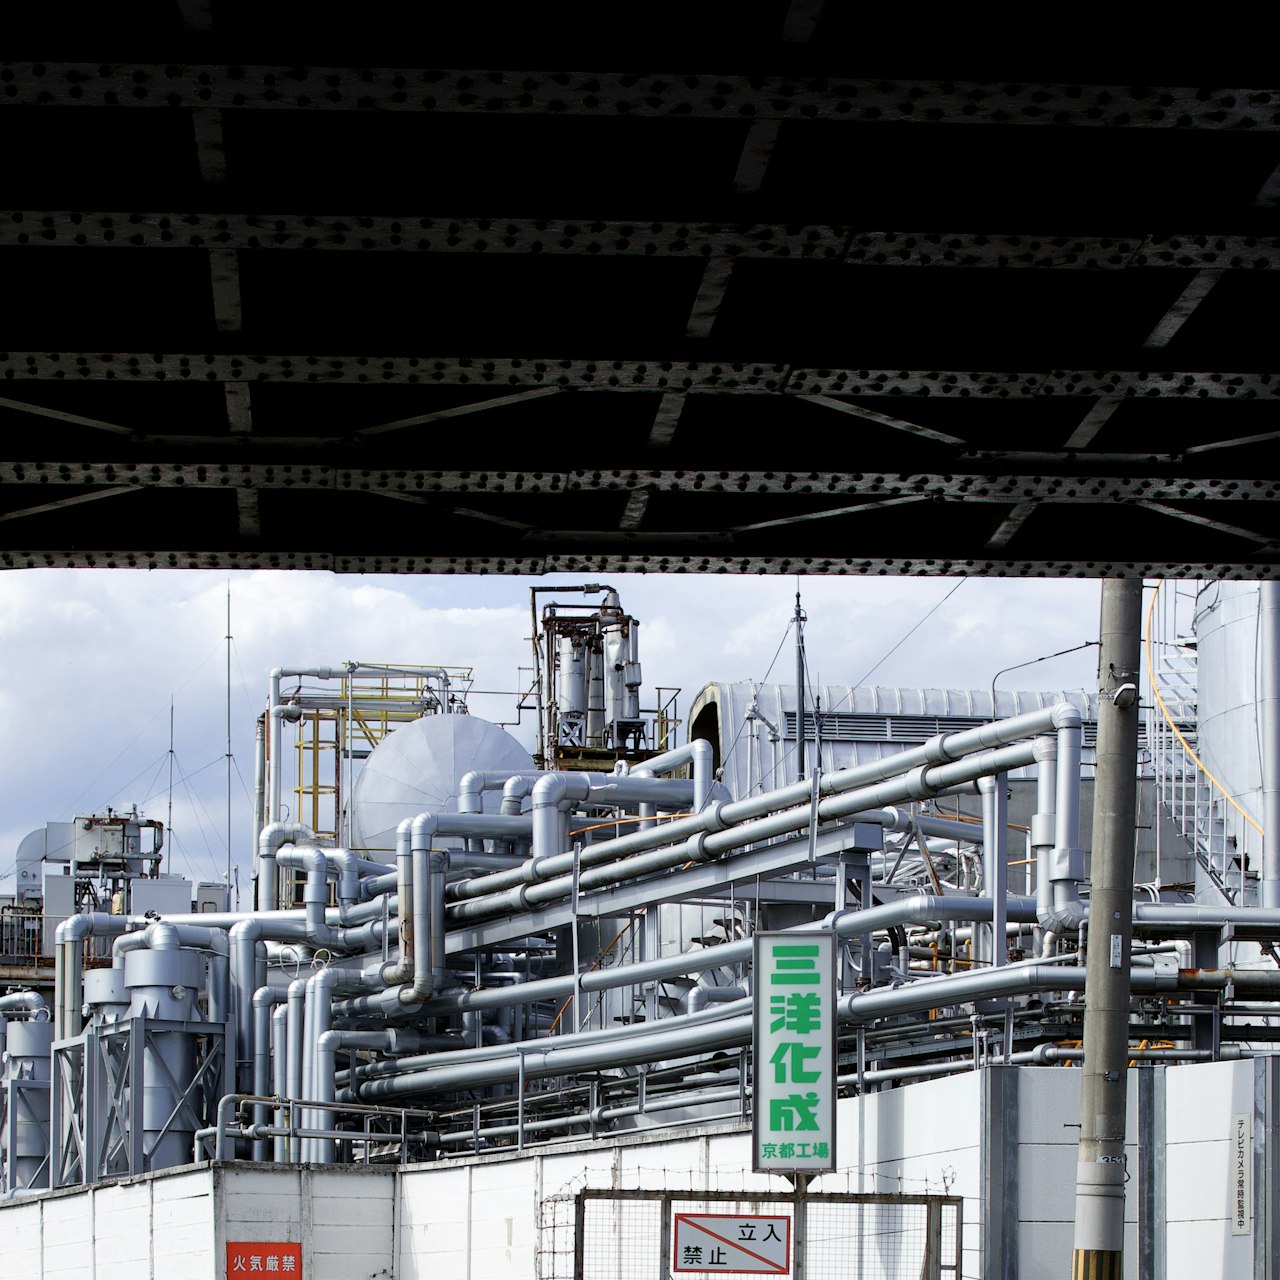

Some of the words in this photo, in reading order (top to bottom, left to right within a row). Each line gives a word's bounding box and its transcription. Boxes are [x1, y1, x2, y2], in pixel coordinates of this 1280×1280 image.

[769, 945, 822, 1132] 三洋化成
[761, 1142, 829, 1159] 京都工場
[738, 1223, 782, 1242] 立入
[233, 1255, 296, 1272] 火気厳禁
[683, 1246, 727, 1265] 禁止
